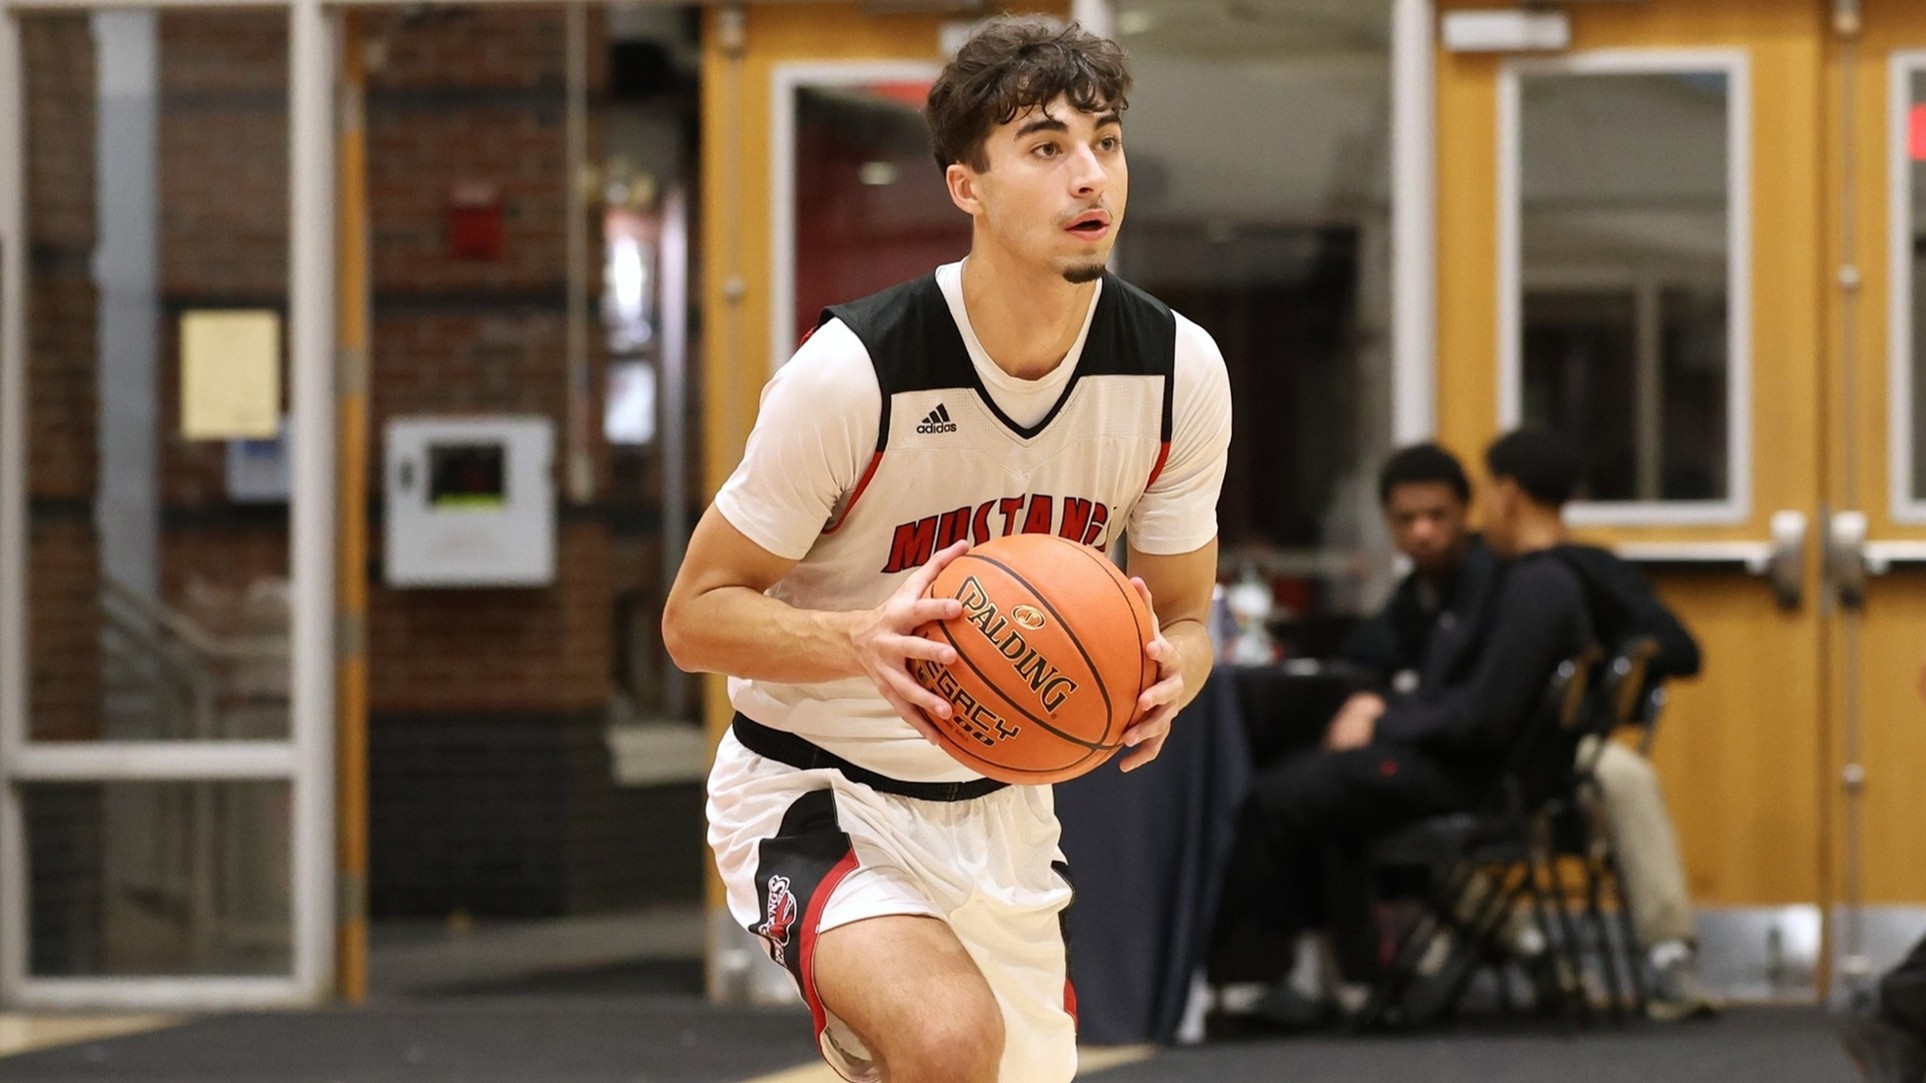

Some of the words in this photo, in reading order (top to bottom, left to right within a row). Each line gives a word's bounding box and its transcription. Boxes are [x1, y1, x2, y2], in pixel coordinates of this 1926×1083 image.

[916, 422, 957, 434] adidas
[954, 575, 1078, 714] PALDING
[921, 660, 1020, 740] EGACY
